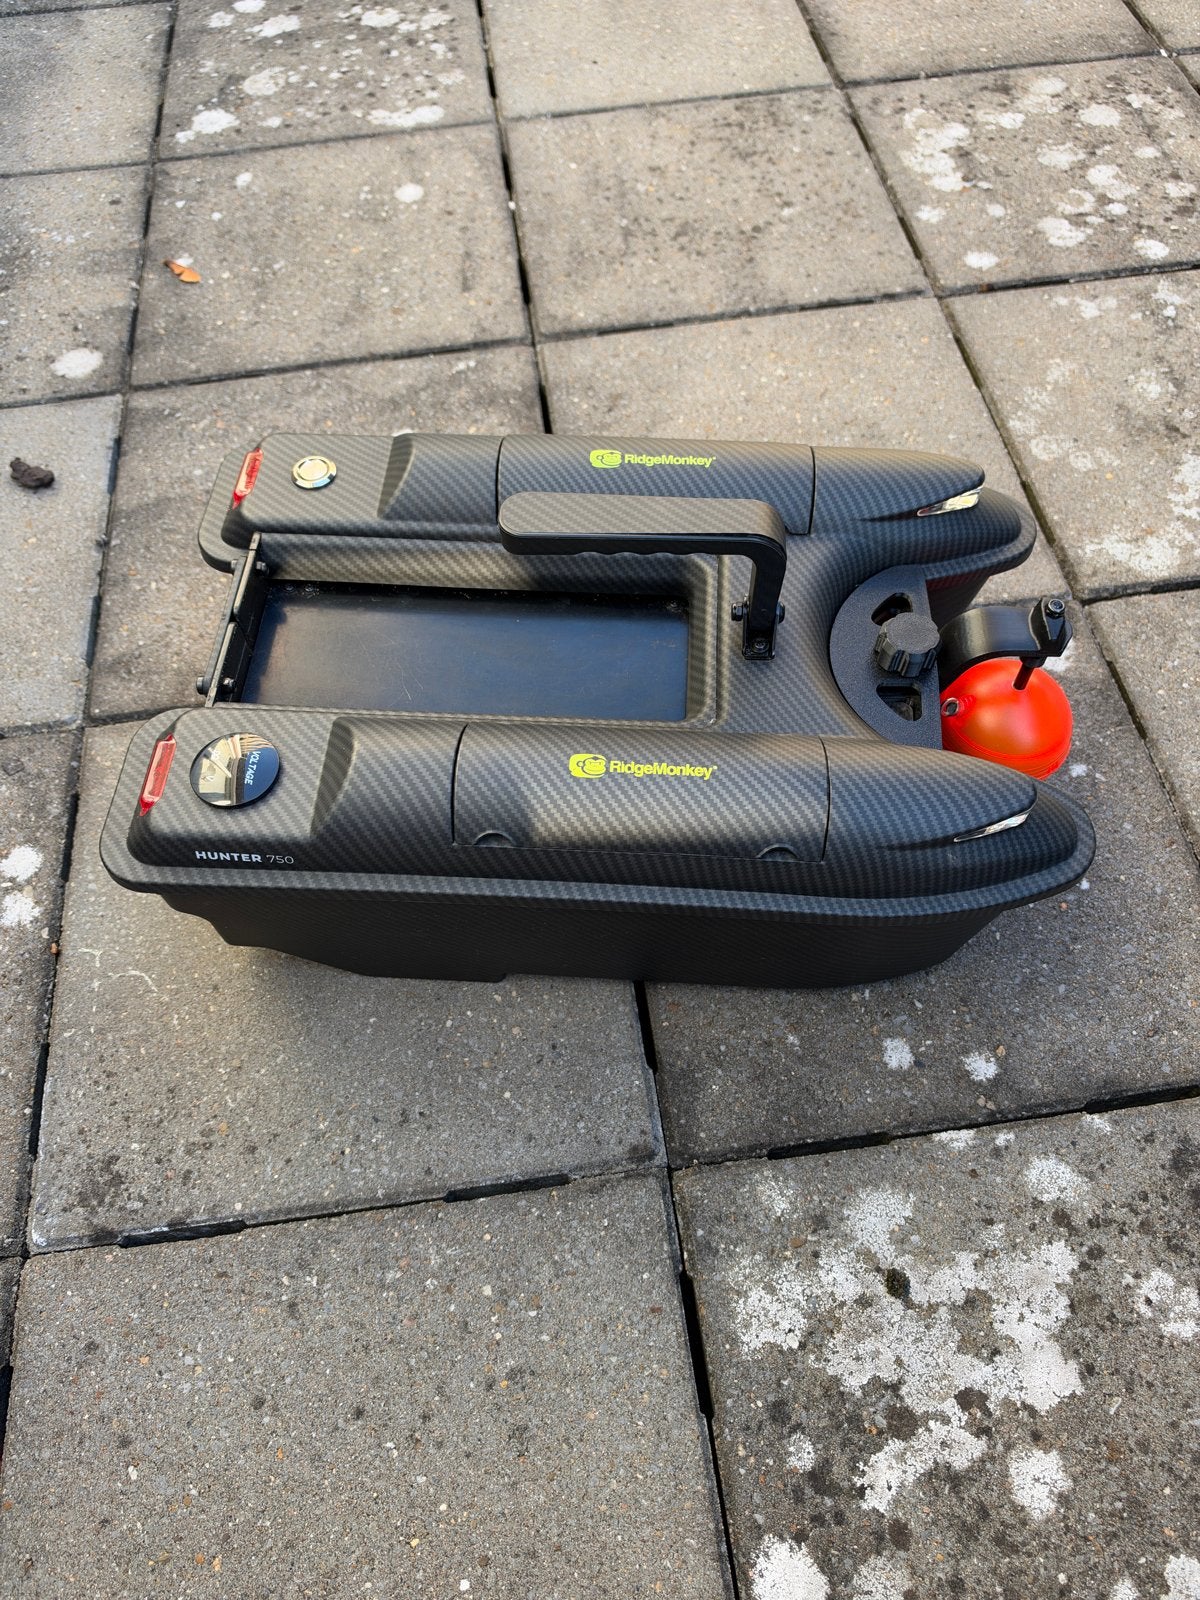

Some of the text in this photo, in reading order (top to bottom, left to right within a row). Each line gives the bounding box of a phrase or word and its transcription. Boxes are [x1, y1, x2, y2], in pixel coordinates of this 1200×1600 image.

[624, 453, 714, 468] RidgeMonkey
[244, 750, 262, 786] VOLTAGE
[609, 760, 714, 780] RidgeMonkey
[194, 850, 295, 865] HUNTER 750
